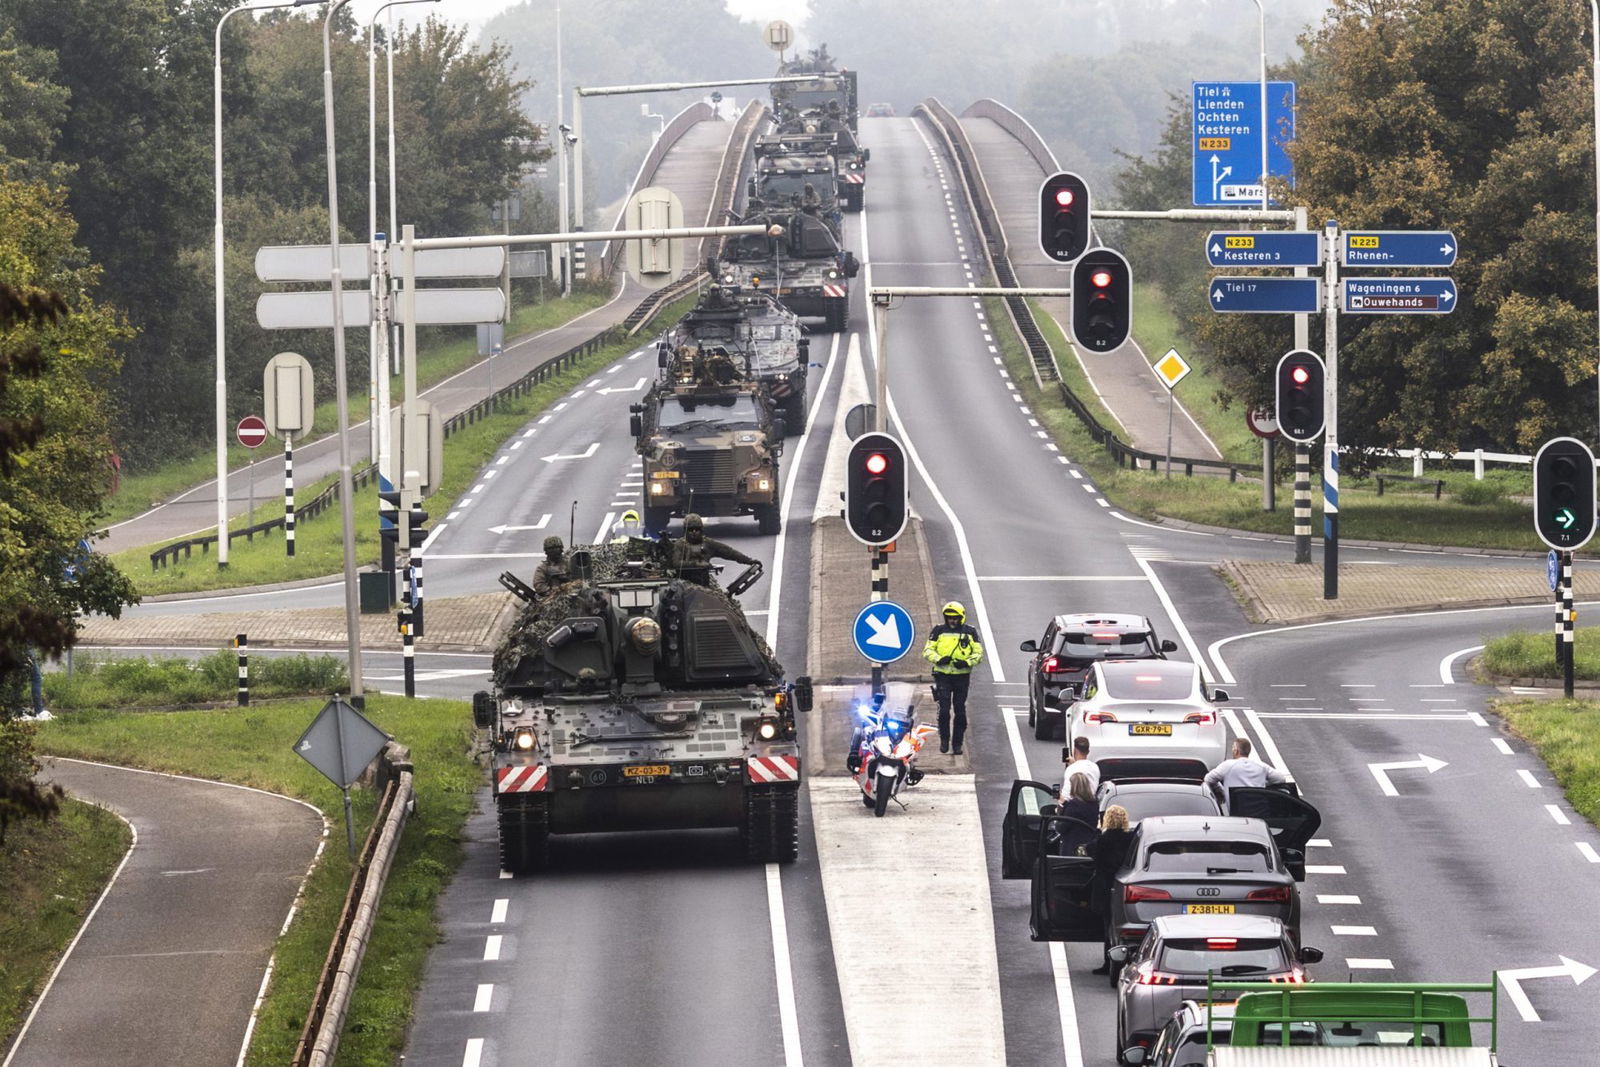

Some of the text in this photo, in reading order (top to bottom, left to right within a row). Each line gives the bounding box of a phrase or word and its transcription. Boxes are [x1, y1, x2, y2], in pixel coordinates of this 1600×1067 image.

[1198, 87, 1219, 96] Tiel
[1198, 100, 1244, 109] Lienden
[1198, 112, 1239, 122] Ochten
[1198, 125, 1250, 134] Kesteren
[1224, 252, 1271, 260] Kesteren
[1226, 283, 1244, 292] Tiel
[1348, 284, 1412, 294] Wageningen
[1364, 298, 1423, 306] Ouwehands
[636, 776, 654, 784] NLD
[1192, 906, 1230, 914] Z-381-LH
